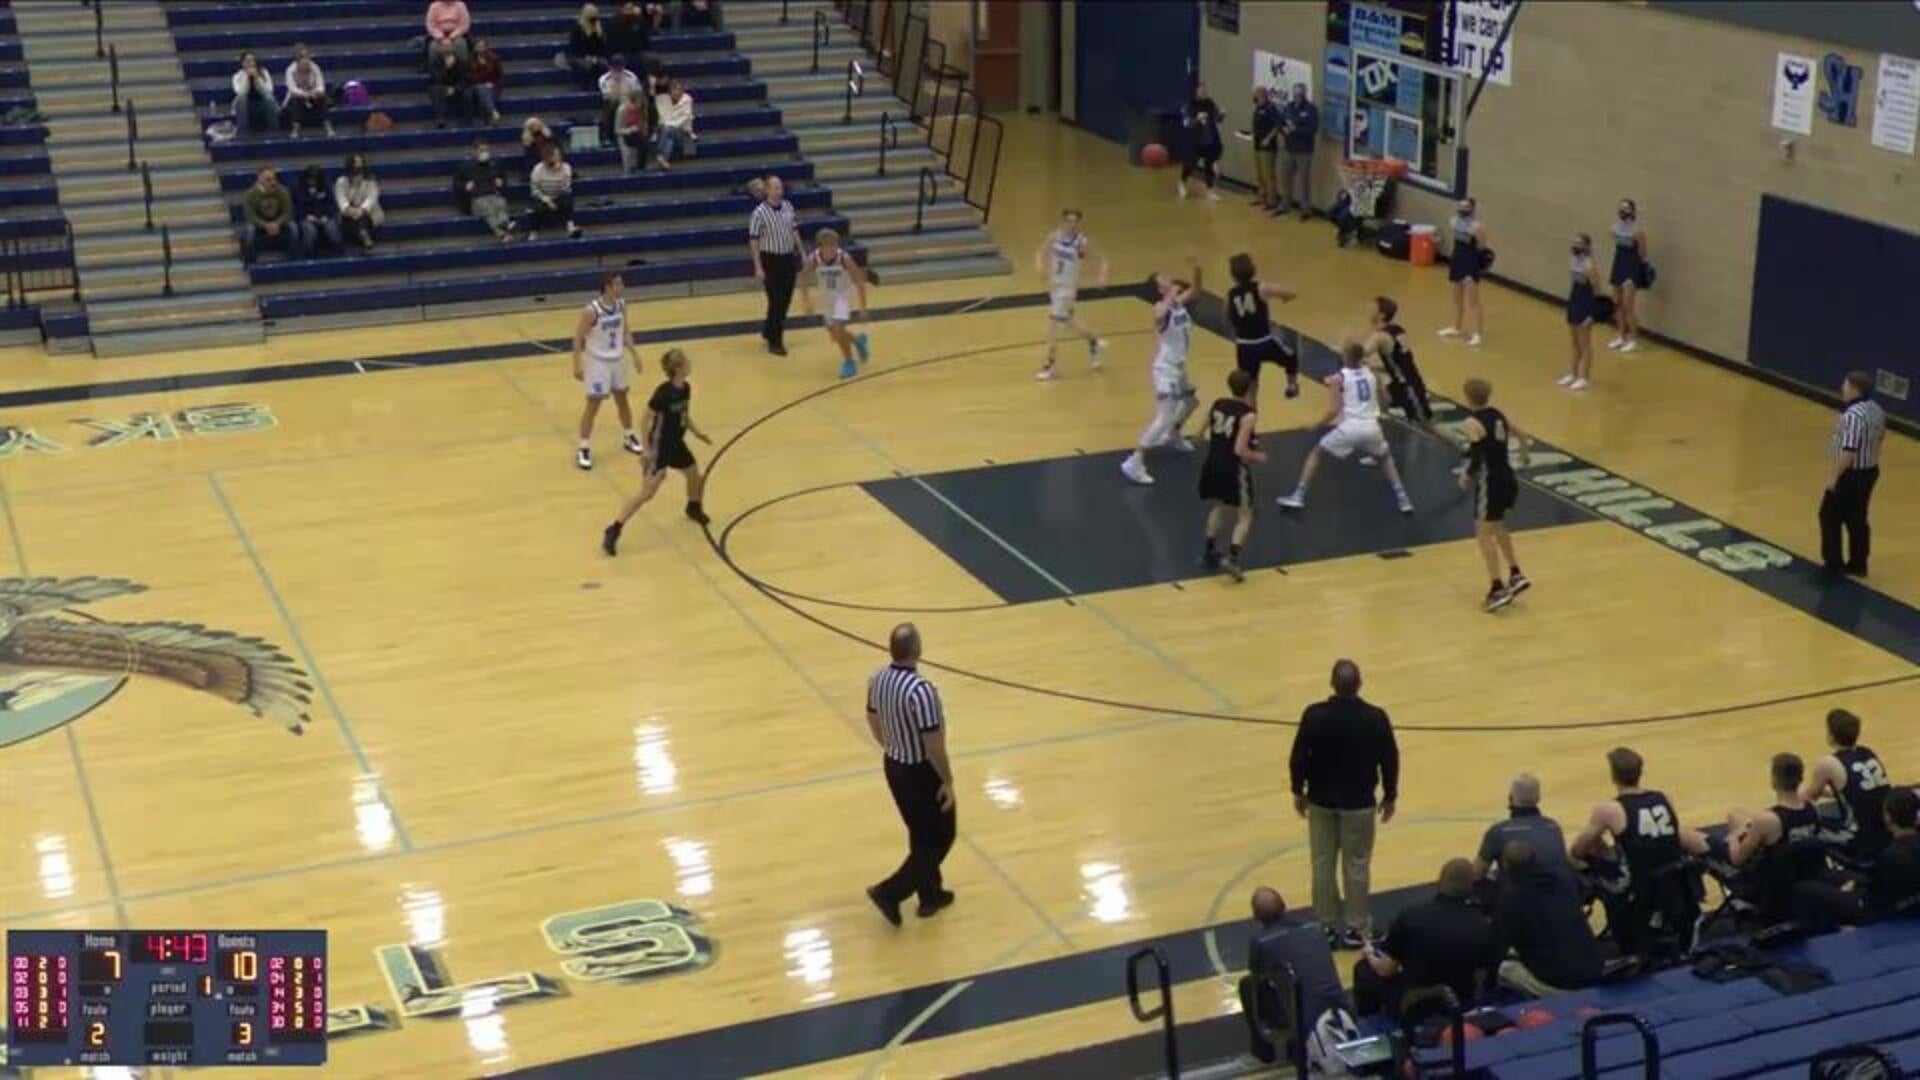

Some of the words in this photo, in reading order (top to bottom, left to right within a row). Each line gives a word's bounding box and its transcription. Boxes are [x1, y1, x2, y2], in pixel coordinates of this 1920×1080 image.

[1533, 468, 1793, 572] HILLS
[1851, 758, 1889, 791] 32
[1637, 804, 1676, 839] 42
